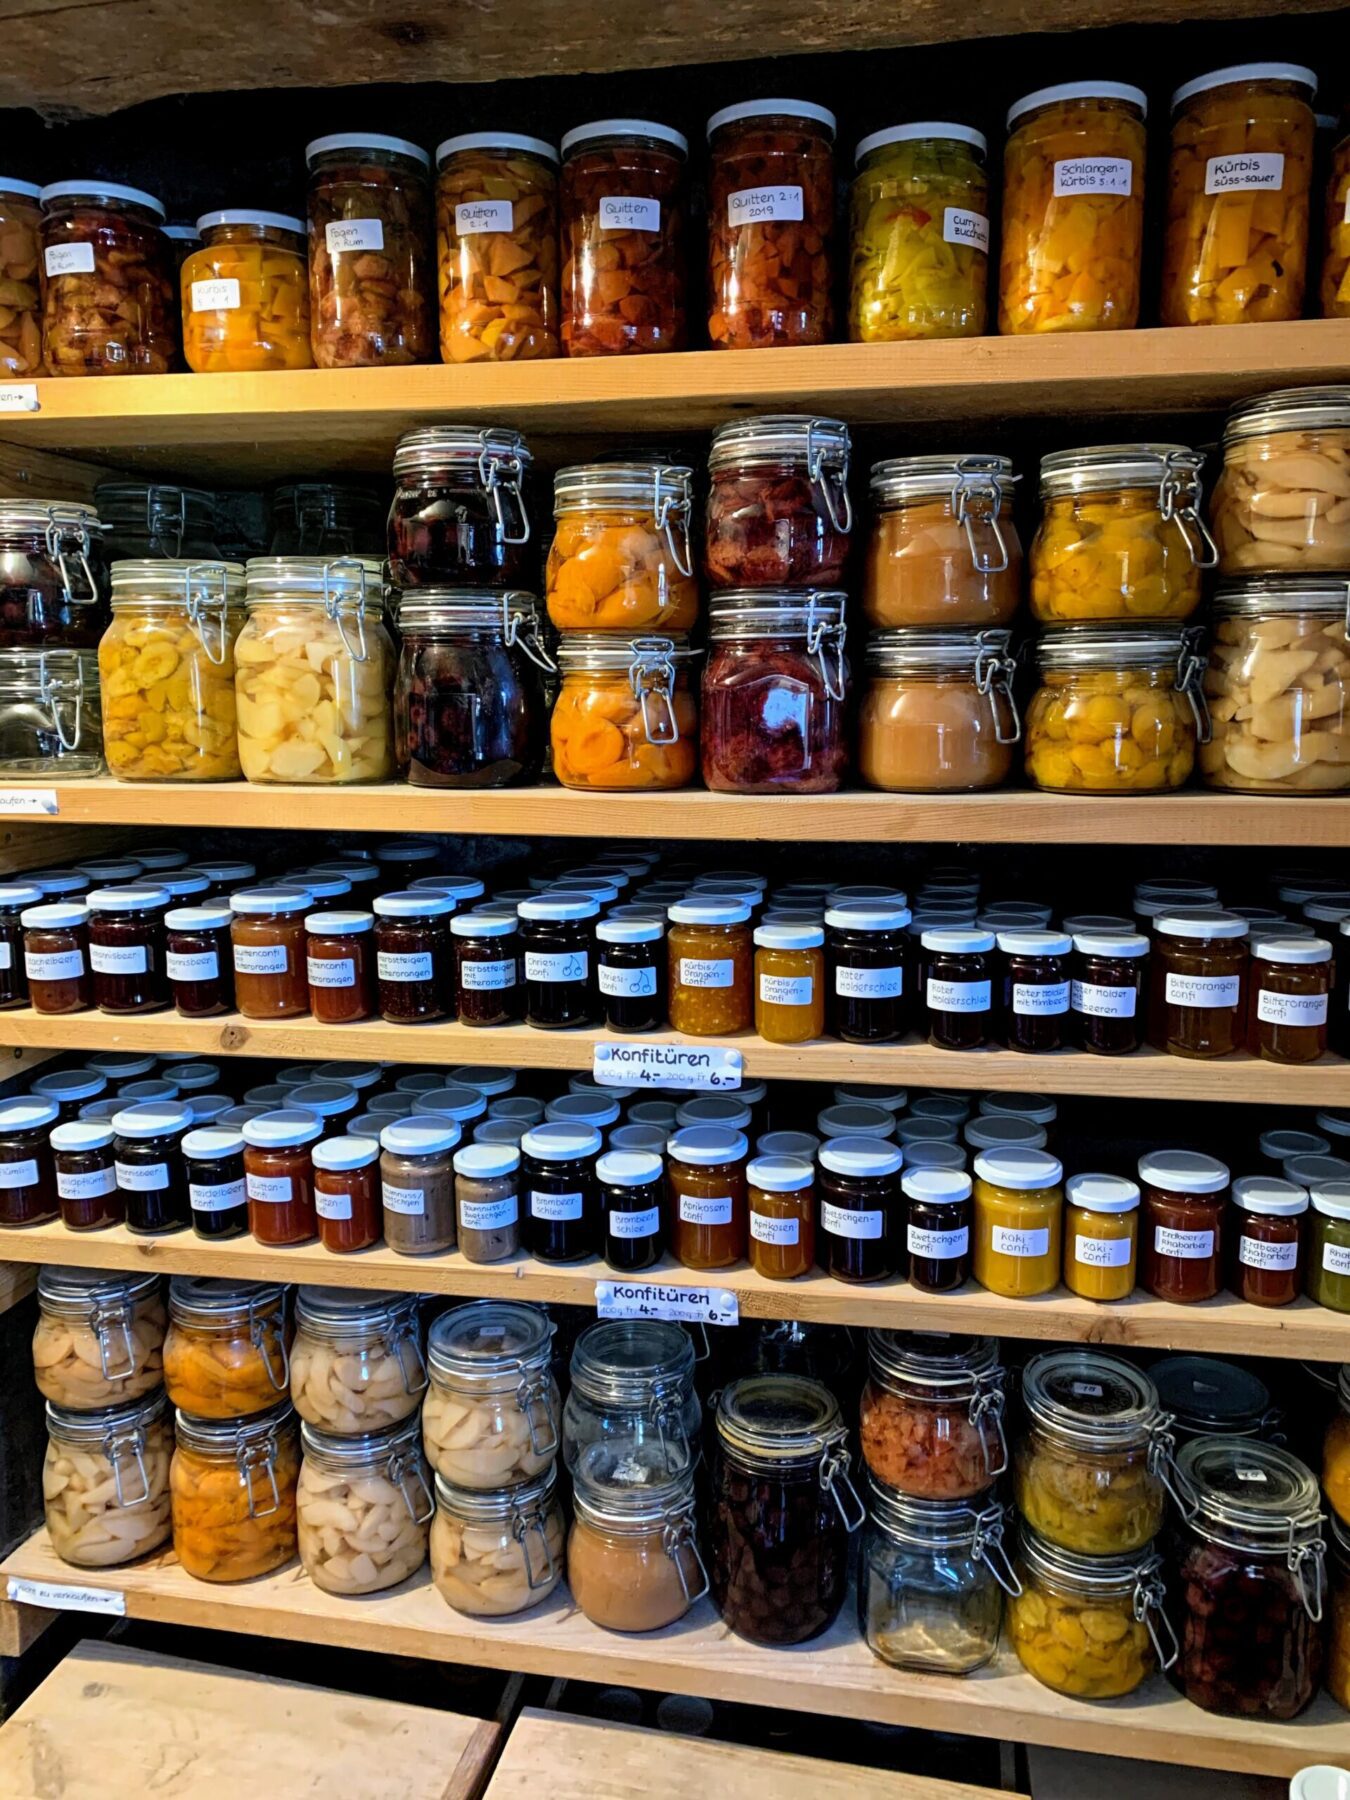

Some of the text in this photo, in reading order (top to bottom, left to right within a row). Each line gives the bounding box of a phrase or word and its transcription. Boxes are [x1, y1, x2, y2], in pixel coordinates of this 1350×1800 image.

[1214, 158, 1261, 175] Kürbis
[605, 201, 649, 214] Quitten
[732, 192, 775, 209] Quitten
[460, 205, 498, 221] Quitten
[749, 205, 774, 217] 2019
[611, 1048, 710, 1067] Konfitüren
[614, 1286, 710, 1305] Konfitüren
